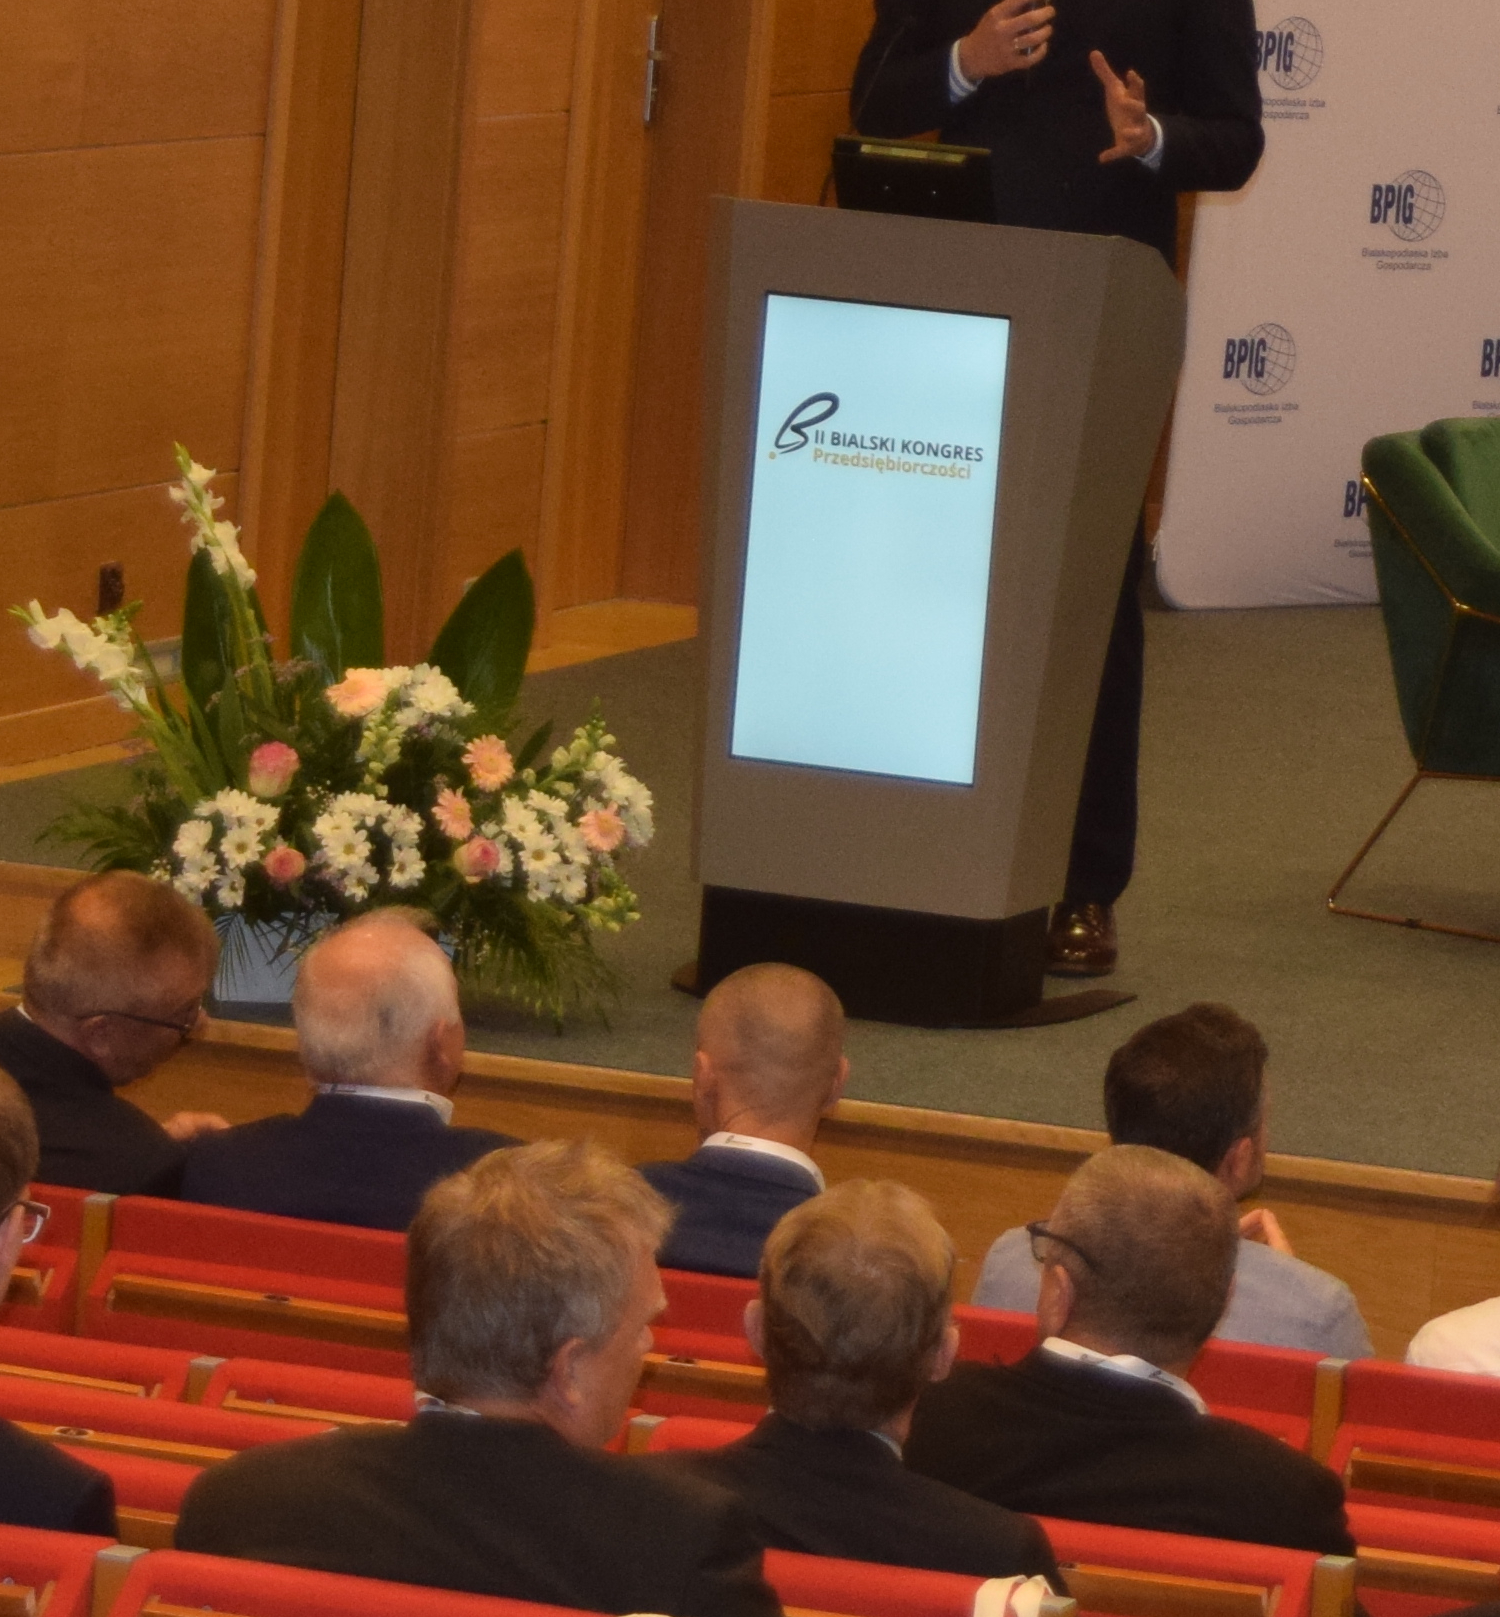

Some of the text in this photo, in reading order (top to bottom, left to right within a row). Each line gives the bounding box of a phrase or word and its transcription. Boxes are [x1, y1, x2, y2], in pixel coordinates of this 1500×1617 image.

[1370, 184, 1414, 225] BPIG
[1223, 338, 1267, 380] BPIG
[812, 447, 971, 480] Przedsiębiorczości
[831, 431, 895, 452] BIALSKI
[901, 439, 984, 462] KONGRES
